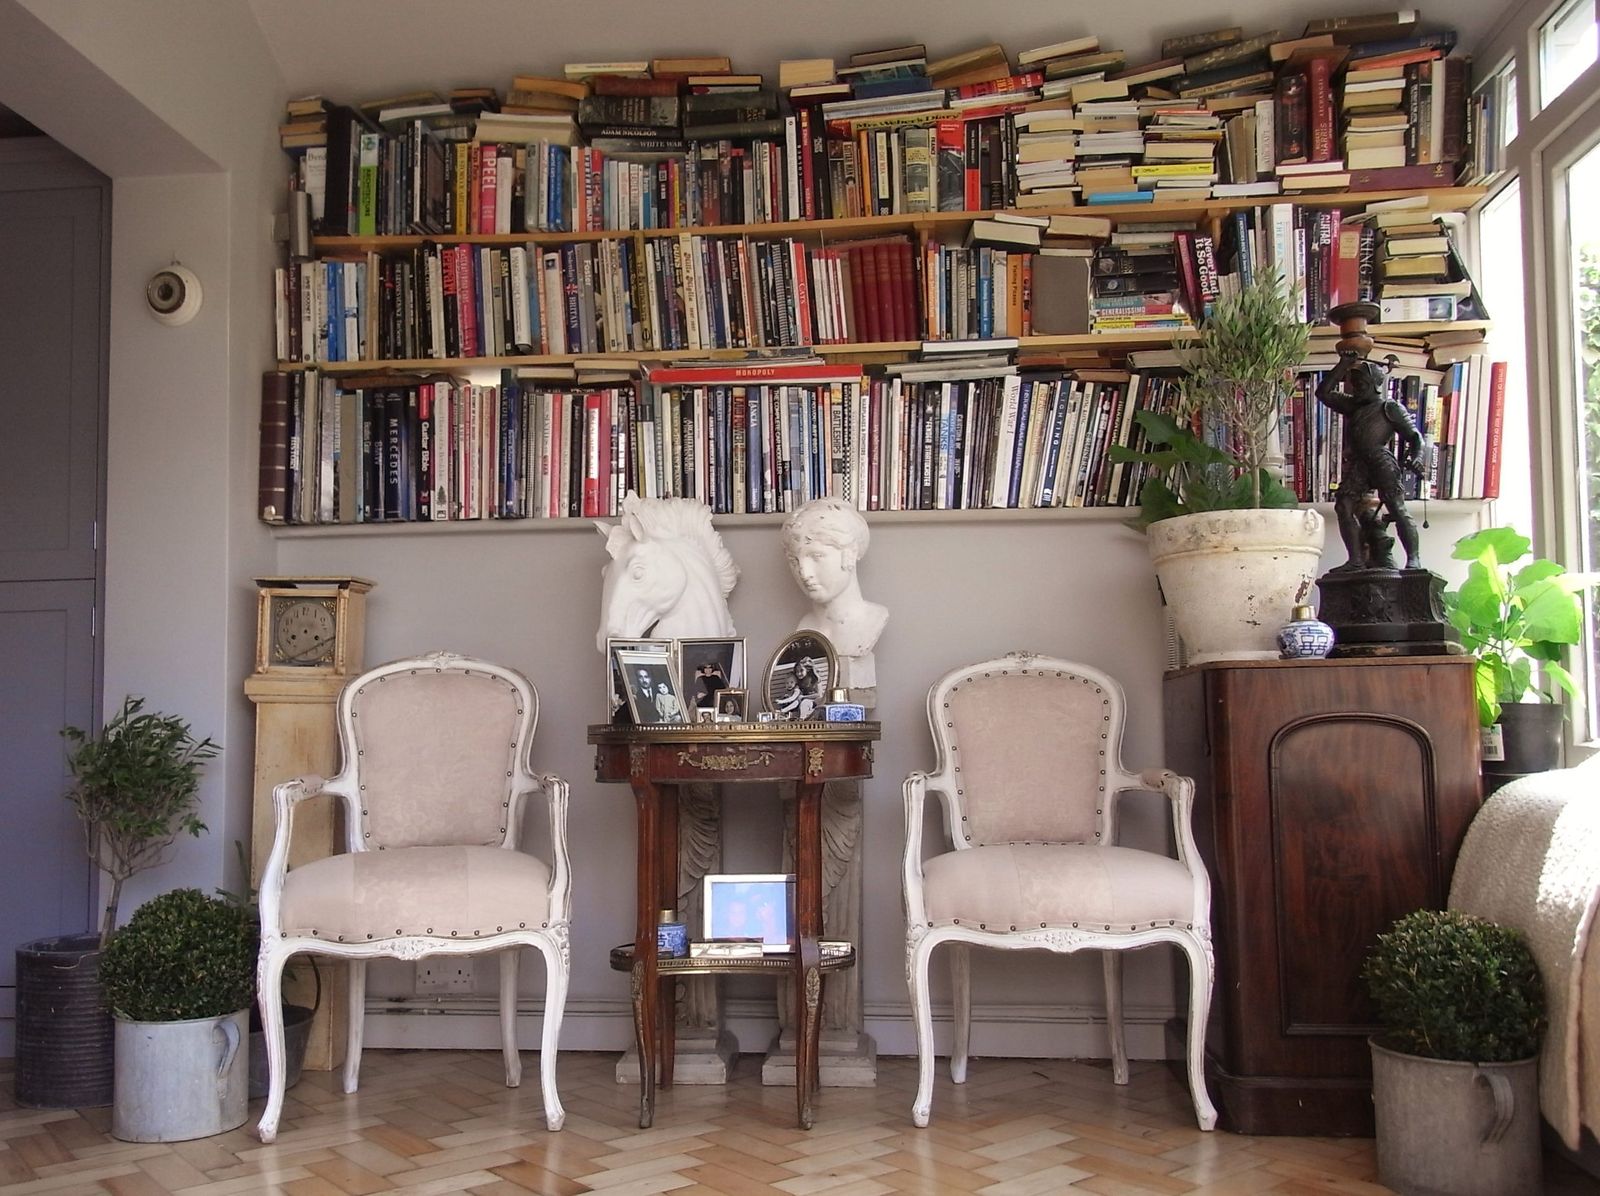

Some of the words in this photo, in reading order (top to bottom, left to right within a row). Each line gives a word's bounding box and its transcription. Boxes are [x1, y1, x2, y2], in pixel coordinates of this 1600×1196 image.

[925, 112, 961, 123] Diary
[1320, 122, 1329, 155] HARRIS
[482, 158, 497, 193] PEEL
[364, 168, 372, 217] ARCHITECTURE
[1194, 238, 1203, 249] It
[1320, 215, 1331, 245] GUITAR
[567, 250, 575, 282] Yesterday's
[673, 243, 681, 268] GUNS
[684, 252, 692, 273] Mille
[1196, 250, 1206, 264] So
[1203, 237, 1215, 270] Never
[1209, 271, 1220, 294] Had
[1359, 237, 1375, 275] KING
[584, 260, 592, 286] Foster
[1198, 266, 1211, 295] Good
[569, 297, 578, 329] BRITAIN
[735, 368, 775, 377] MONOPOLY
[1009, 384, 1019, 410] World
[748, 400, 759, 427] LANCIA
[949, 409, 957, 432] Electric
[1007, 411, 1017, 428] War
[1053, 392, 1067, 445] LIGHTING
[421, 421, 429, 449] Guitar
[734, 416, 744, 444] POWER
[833, 410, 842, 454] BATTLESHIPS
[940, 418, 949, 450] TANKS
[374, 441, 383, 465] BMW
[389, 418, 398, 485] MERCEDES
[421, 450, 429, 472] Bible
[1080, 432, 1093, 471] CRUISERS
[1431, 445, 1439, 468] Guitar
[924, 445, 932, 487] STRATOCASTER
